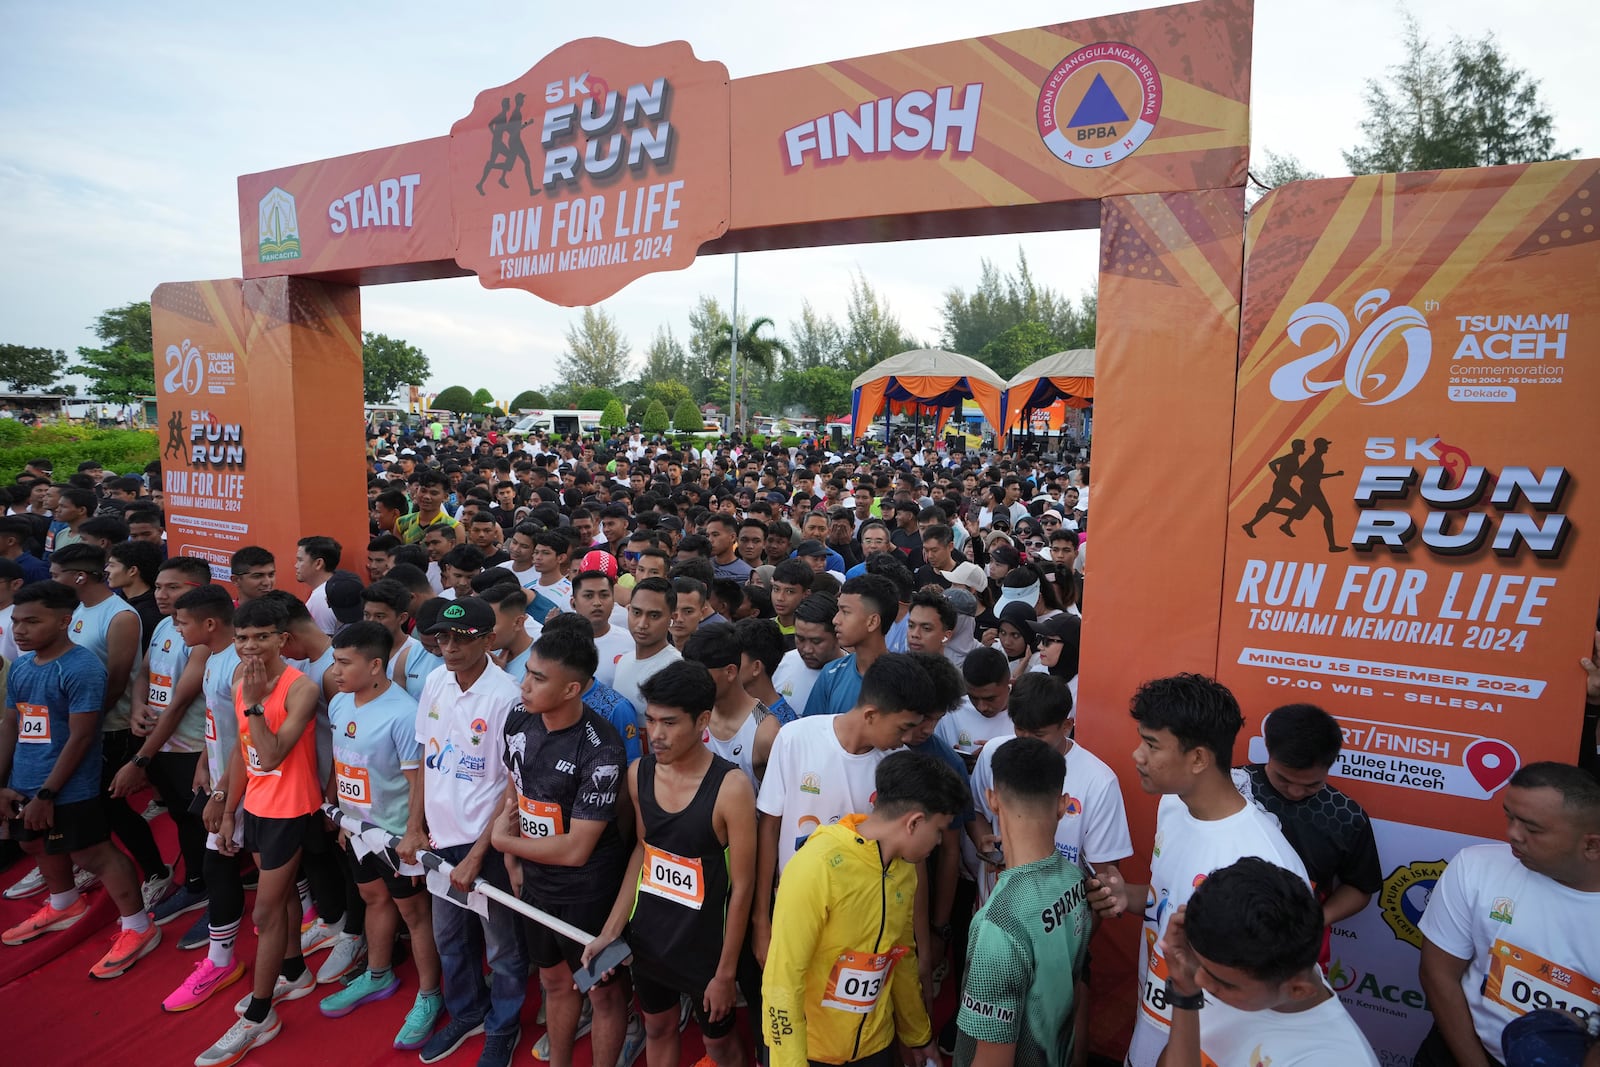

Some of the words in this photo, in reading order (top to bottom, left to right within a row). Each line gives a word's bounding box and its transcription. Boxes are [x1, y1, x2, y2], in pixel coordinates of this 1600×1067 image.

[1043, 90, 1054, 127] BADAN
[1050, 47, 1142, 88] PENANGGULANGAN
[1139, 64, 1156, 115] BENCANA
[541, 76, 668, 147] FUN
[783, 82, 983, 168] FINISH
[1077, 126, 1117, 140] BPBA
[542, 121, 671, 187] RUN
[1064, 139, 1134, 164] ACEH
[328, 173, 421, 235] START
[490, 206, 542, 257] RUN
[550, 195, 605, 247] FOR
[615, 180, 684, 237] LIFE
[262, 251, 299, 261] PANCACITA
[500, 253, 555, 279] TSUNAMI
[558, 241, 628, 271] MEMORIAL
[633, 234, 673, 261] 2024
[1424, 300, 1440, 311] th
[1456, 313, 1569, 331] TSUNAMI
[207, 352, 234, 361] TSUNAMI
[1453, 333, 1567, 360] ACEH
[208, 361, 235, 374] ACEH
[1449, 364, 1564, 375] Commemoration
[1453, 389, 1461, 397] 2
[1464, 389, 1508, 398] Dekade
[190, 424, 241, 442] FUN
[191, 446, 245, 465] RUN
[166, 470, 188, 494] RUN
[192, 472, 214, 496] FOR
[217, 474, 244, 499] LIFE
[1353, 466, 1568, 508] FUN
[170, 495, 194, 507] TSUNAMI
[194, 497, 224, 510] MEMORIAL
[225, 500, 241, 512] 2024
[1351, 510, 1569, 557] RUN
[1236, 560, 1327, 607] RUN
[1335, 565, 1428, 617] FOR
[1439, 572, 1557, 626] LIFE
[1248, 608, 1338, 635] TSUNAMI
[1341, 617, 1455, 646] MEMORIAL
[1463, 626, 1528, 652] 2024
[1249, 653, 1322, 669] MINGGU
[1328, 662, 1350, 672] 15
[1357, 665, 1470, 687] DESEMBER
[1477, 680, 1531, 694] 2024
[147, 687, 167, 702] 218
[1267, 676, 1322, 690] 07.00
[1332, 684, 1373, 697] WIB
[1404, 692, 1503, 713] SELESAI
[1339, 726, 1450, 759] RT/FINISH
[555, 759, 576, 775] UFC
[1341, 764, 1396, 783] Banda
[1399, 773, 1445, 790] Aceh
[1351, 755, 1388, 771] Ulee
[1391, 760, 1446, 781] Lheue,
[338, 779, 361, 797] 650
[519, 815, 549, 837] 889
[655, 863, 693, 890] 0164
[1387, 875, 1410, 904] PUPUK
[1392, 914, 1415, 936] ACEH
[845, 977, 882, 998] 013
[1355, 972, 1428, 1011] Ace
[997, 1007, 1014, 1022] IM
[1356, 1000, 1408, 1019] Kemitraan
